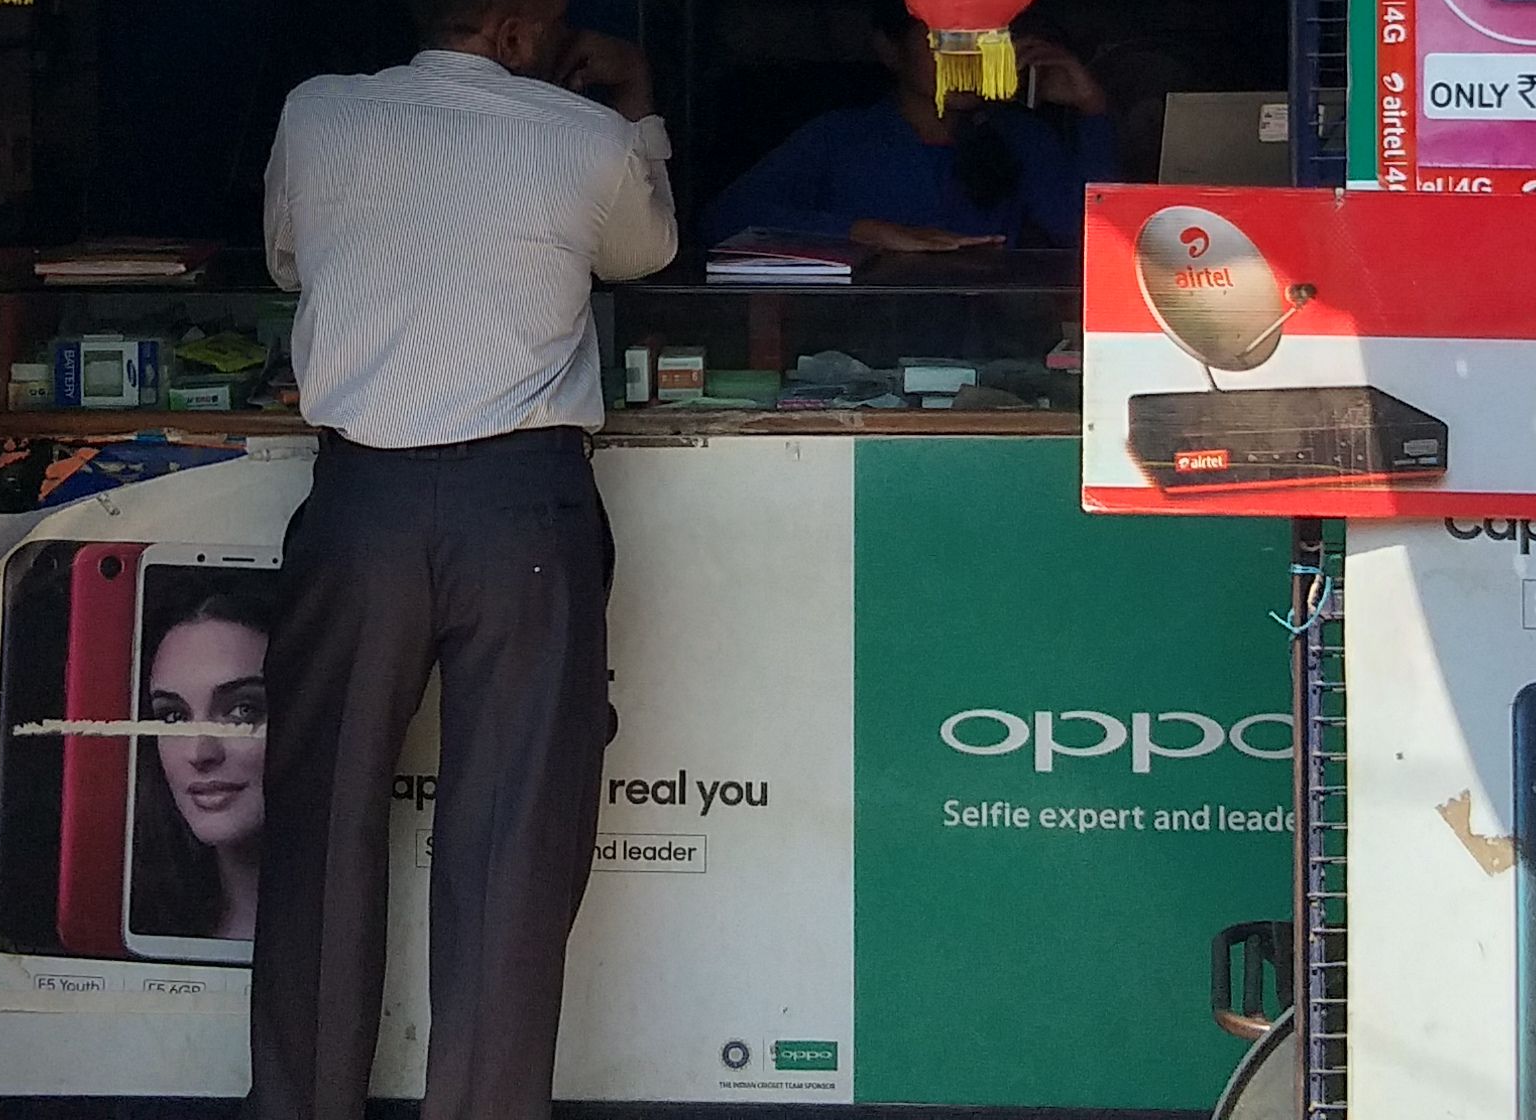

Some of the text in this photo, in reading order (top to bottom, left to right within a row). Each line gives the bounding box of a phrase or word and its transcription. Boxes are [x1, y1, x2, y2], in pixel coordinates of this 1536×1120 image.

[1431, 81, 1509, 109] ONLY
[1175, 265, 1234, 289] airtel
[63, 348, 76, 404] BATTERY
[1189, 454, 1224, 469] airtel
[609, 769, 768, 816] real you
[943, 799, 1295, 833] Selfie expert and leade
[623, 841, 697, 861] leader
